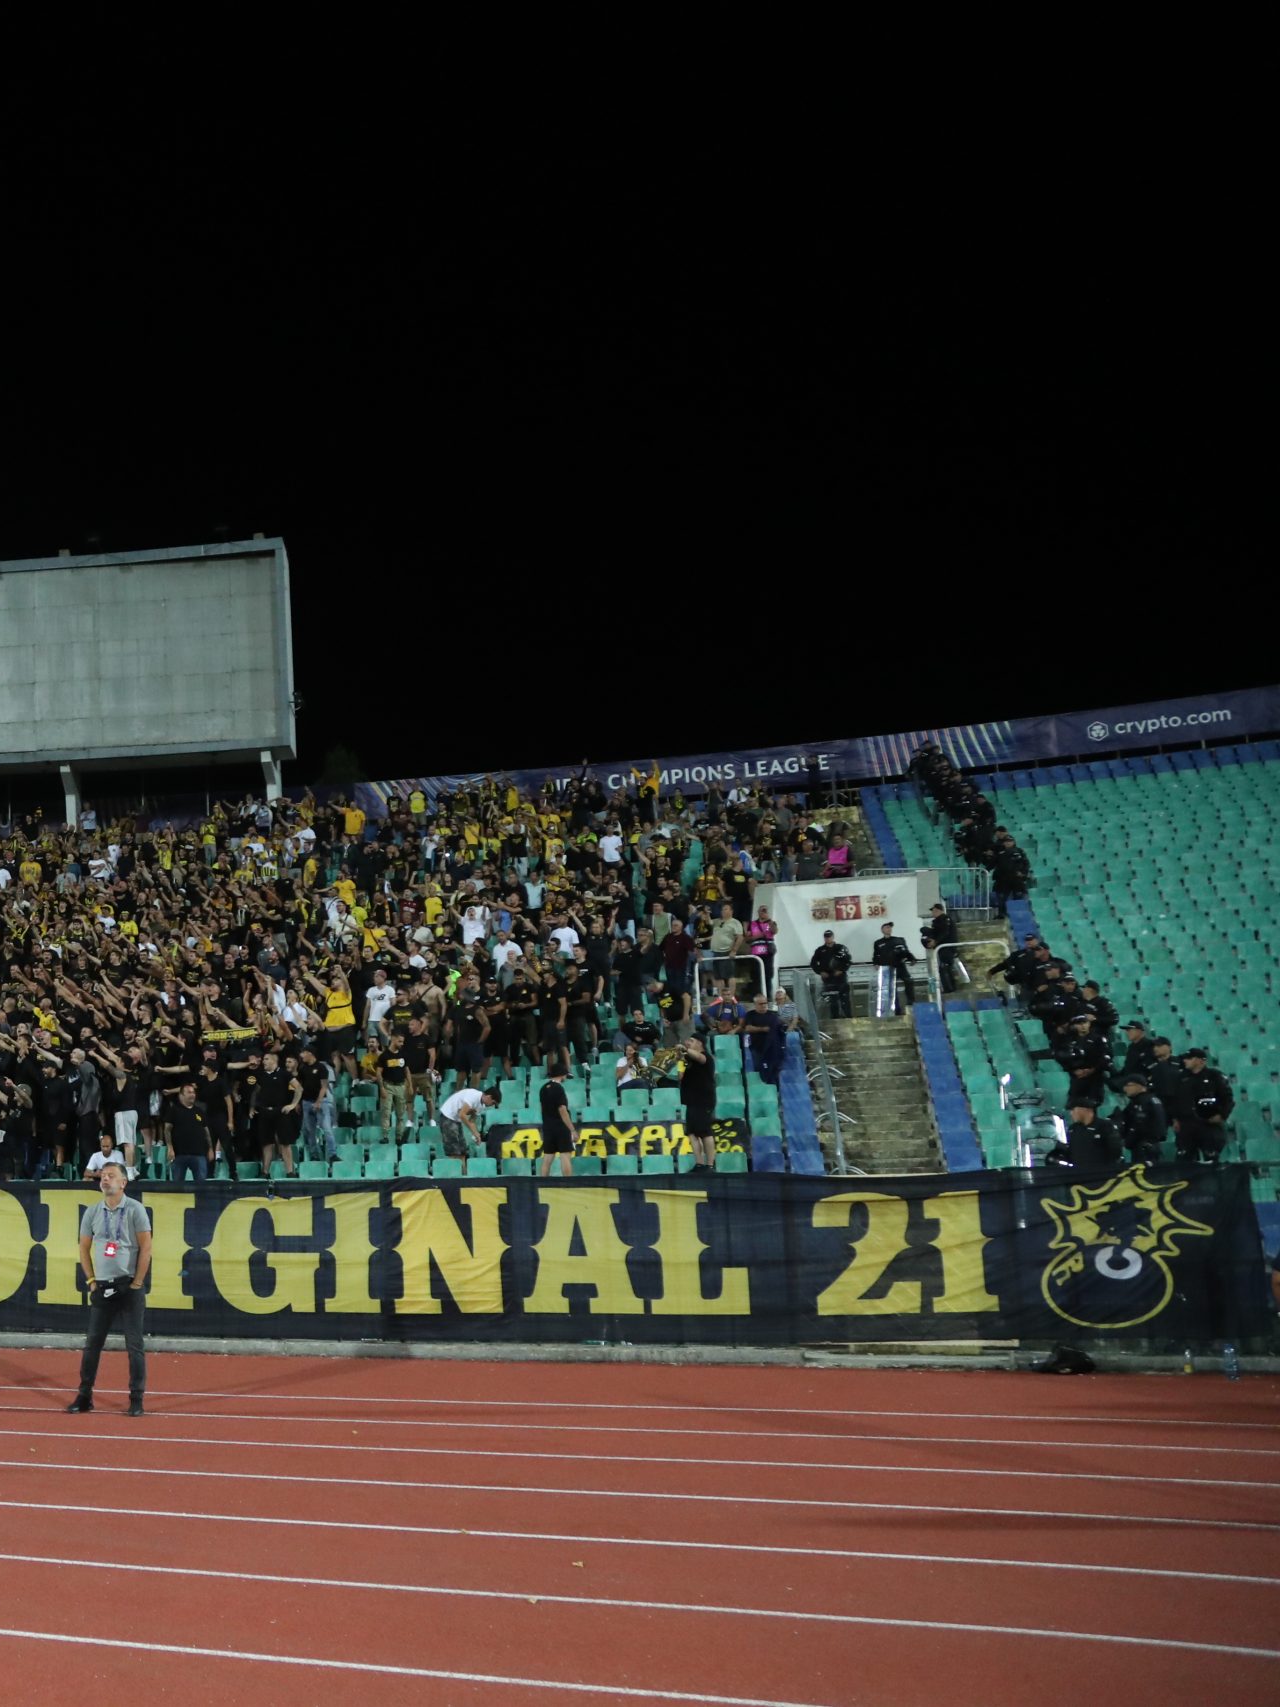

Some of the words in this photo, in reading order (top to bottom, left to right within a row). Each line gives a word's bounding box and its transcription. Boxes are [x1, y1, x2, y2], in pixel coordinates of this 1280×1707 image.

[1114, 709, 1232, 734] crypto.com
[607, 762, 736, 791] CHMPIONS
[811, 1189, 1001, 1317] 21
